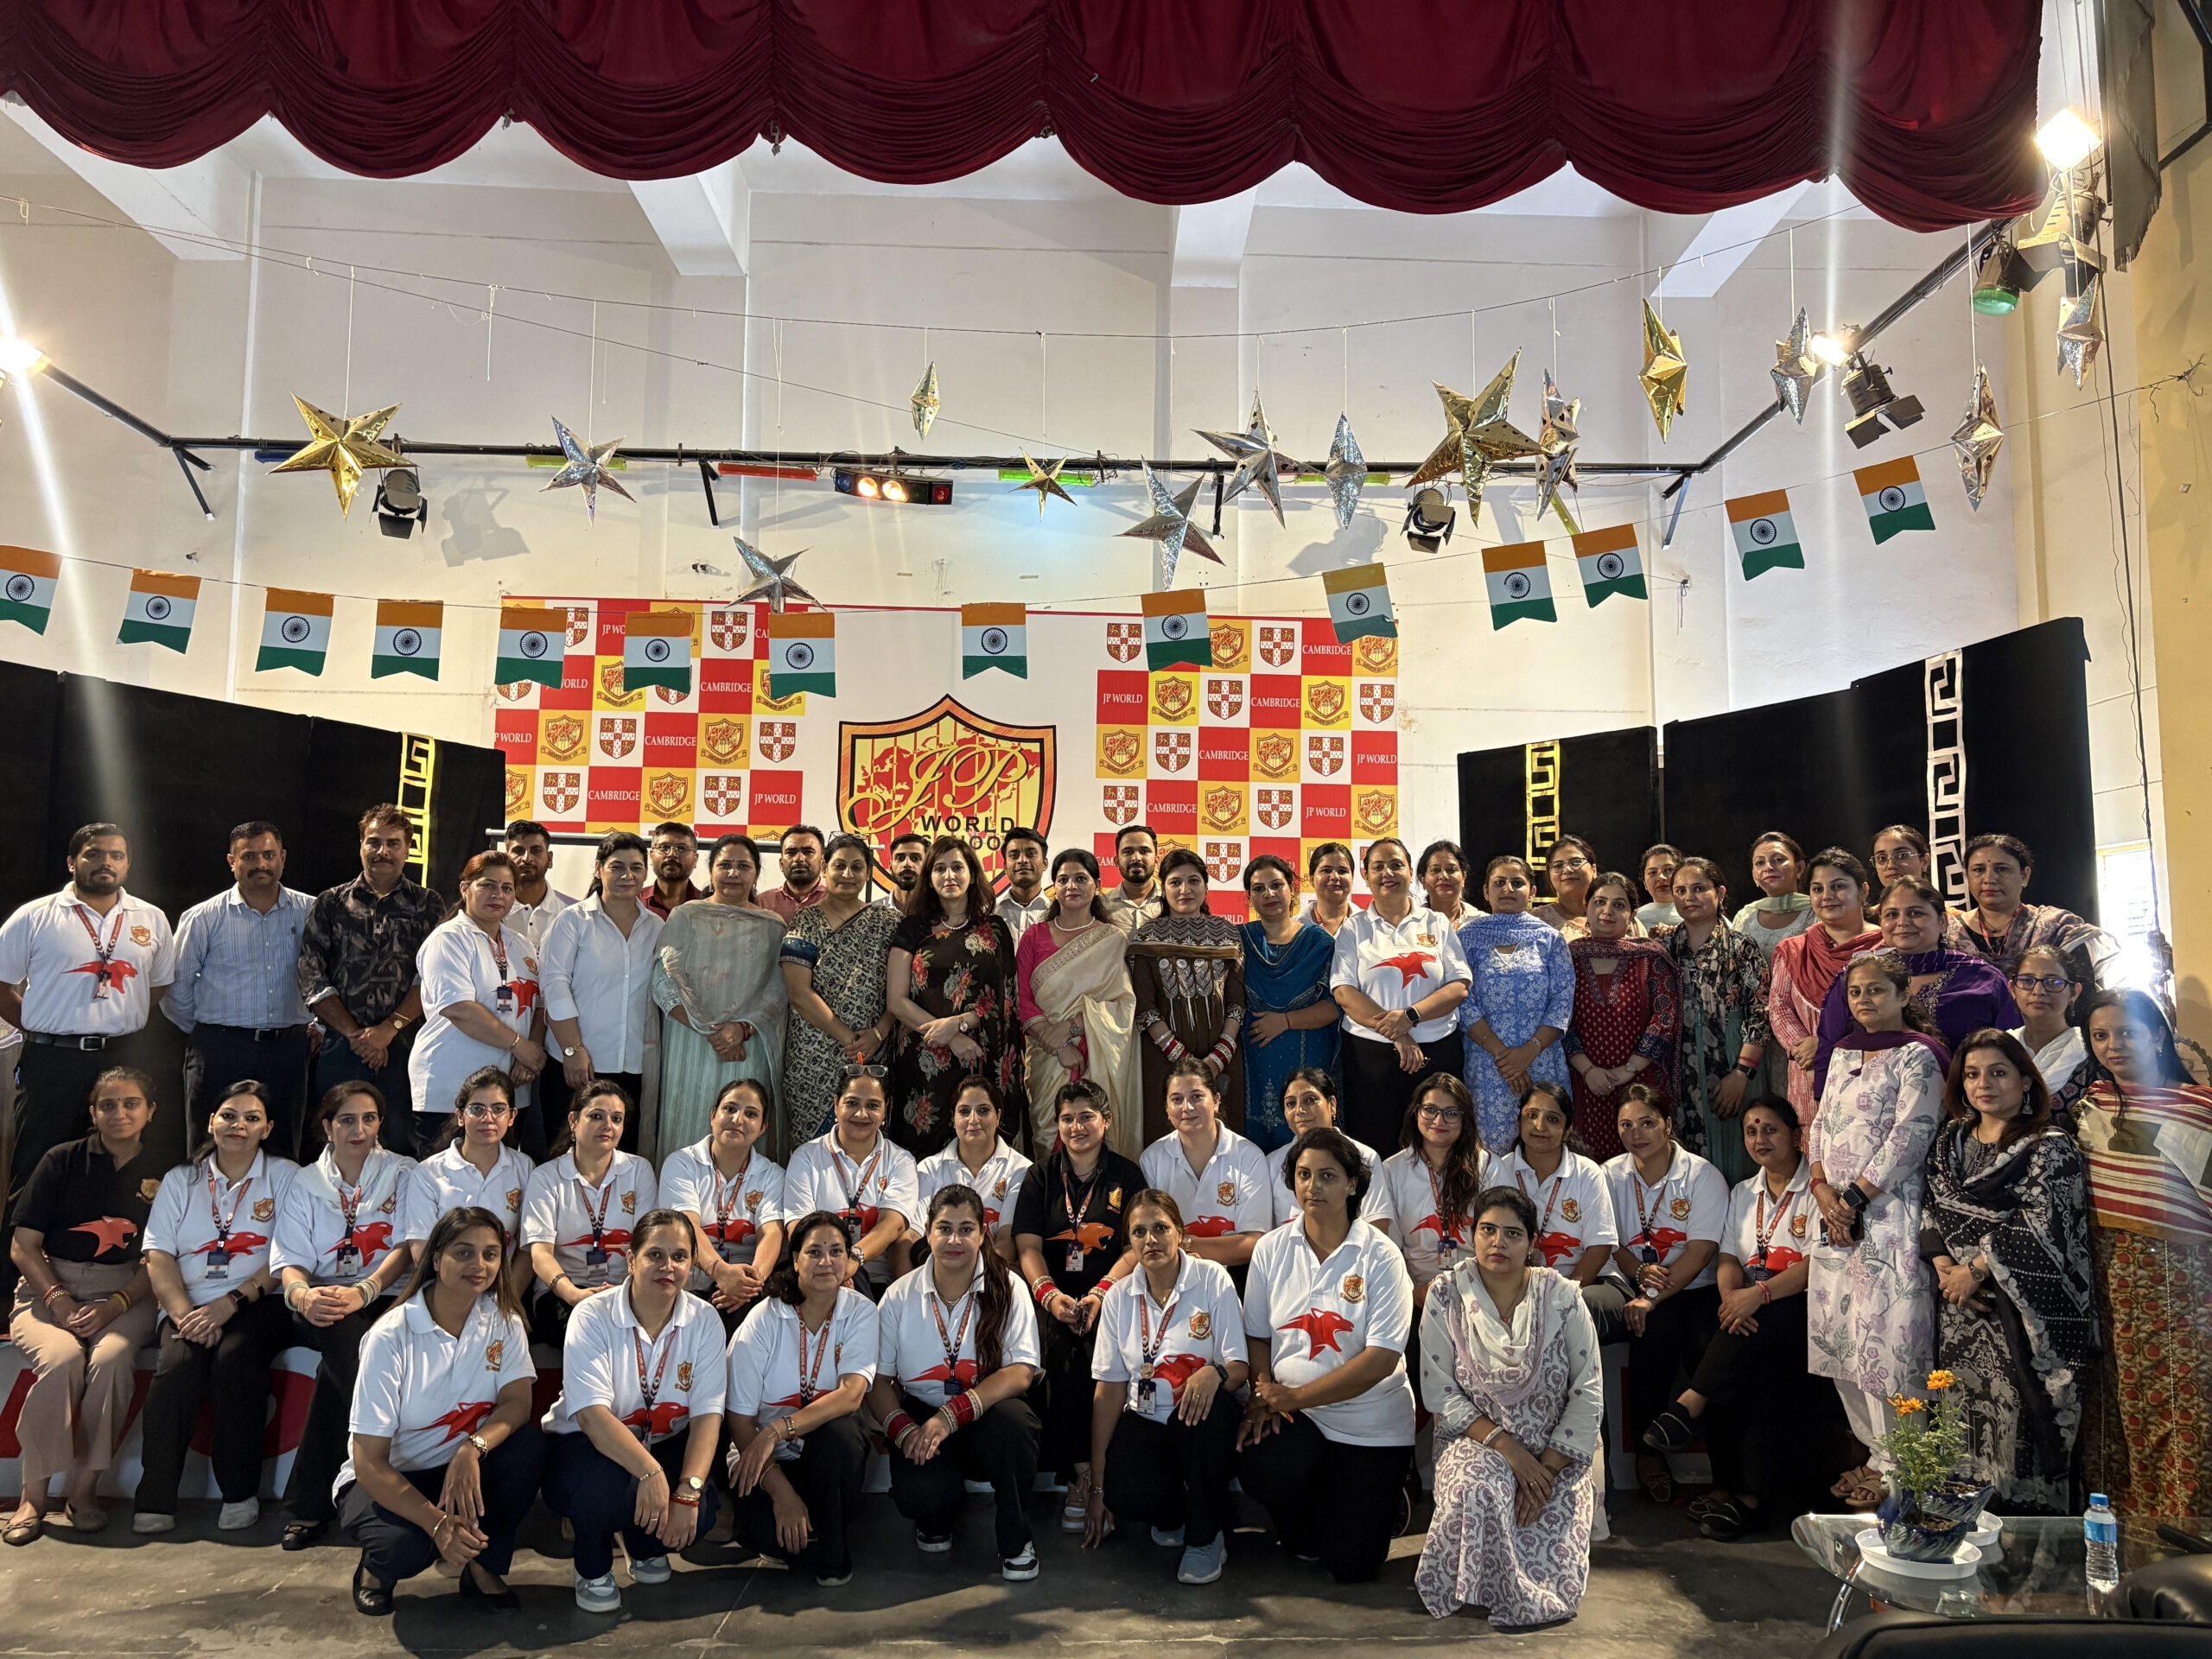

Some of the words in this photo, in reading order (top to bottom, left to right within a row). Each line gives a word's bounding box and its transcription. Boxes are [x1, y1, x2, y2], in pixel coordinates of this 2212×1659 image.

[601, 624, 611, 636] JP
[1302, 645, 1351, 655] CAMBRIDGE
[700, 682, 752, 693] CAMBRIDGE
[1103, 693, 1111, 704] JP
[1111, 694, 1143, 703] WORLD
[1250, 697, 1300, 708] CAMBRIDGE
[500, 733, 532, 743] WORLD
[645, 735, 696, 747] CAMBRIDGE
[1198, 750, 1249, 760] CAMBRIDGE
[1357, 753, 1365, 766] JP
[1365, 754, 1397, 764] WORLD
[843, 744, 1028, 835] JP
[588, 790, 640, 801] CAMBRIDGE
[753, 793, 763, 805] JP
[764, 794, 797, 804] WORLD
[1147, 803, 1197, 814] CAMBRIDGE
[1306, 806, 1314, 818] JP
[1314, 807, 1346, 817] WORLD
[921, 816, 1014, 833] WORLD
[819, 1332, 828, 1351] SCHOOL
